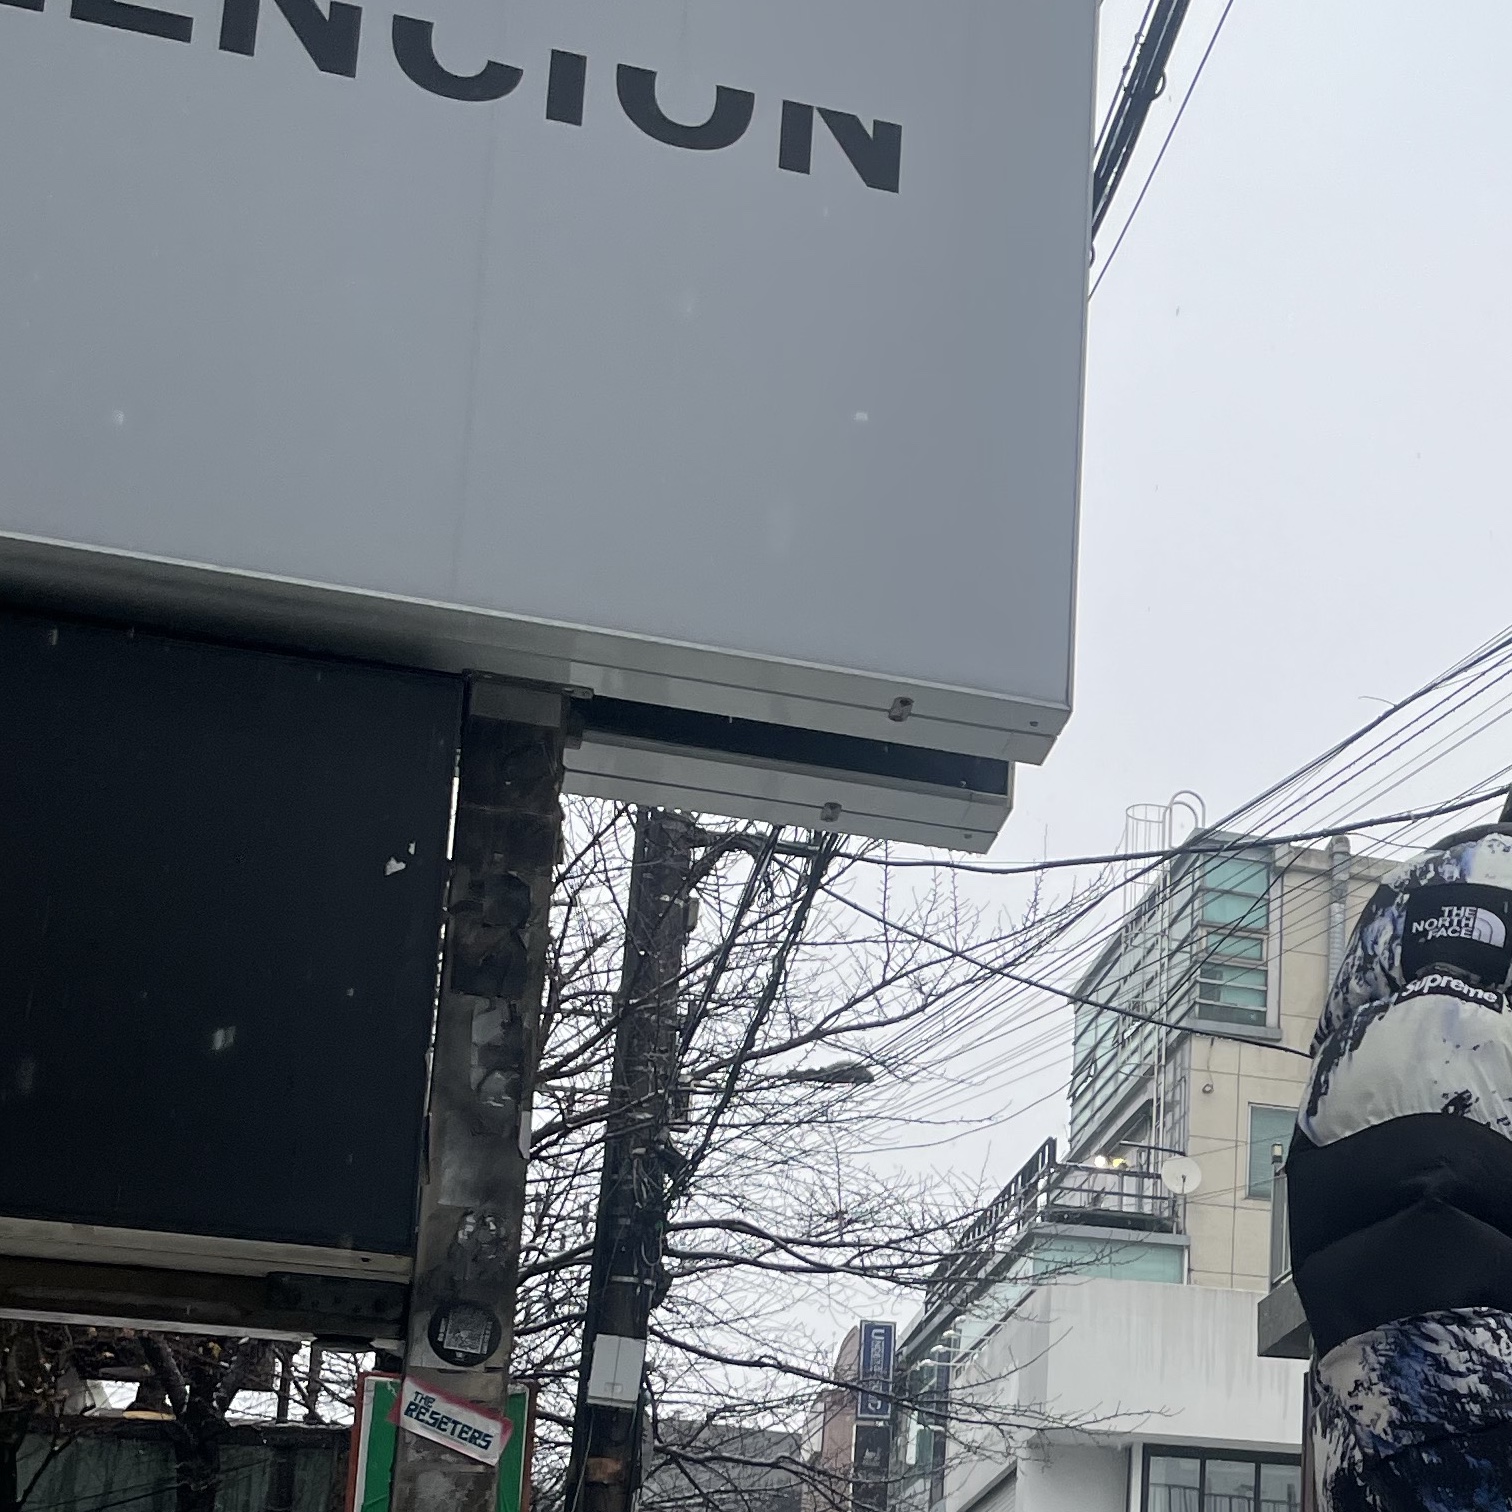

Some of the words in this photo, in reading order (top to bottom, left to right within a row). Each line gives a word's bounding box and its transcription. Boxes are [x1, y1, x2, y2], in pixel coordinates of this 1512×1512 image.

[1441, 906, 1476, 918] THE
[1411, 917, 1474, 933] NORTH
[1427, 926, 1473, 940] FACE
[1401, 973, 1498, 1003] Supreme
[413, 1390, 436, 1408] THE
[404, 1400, 494, 1451] RESETERS
